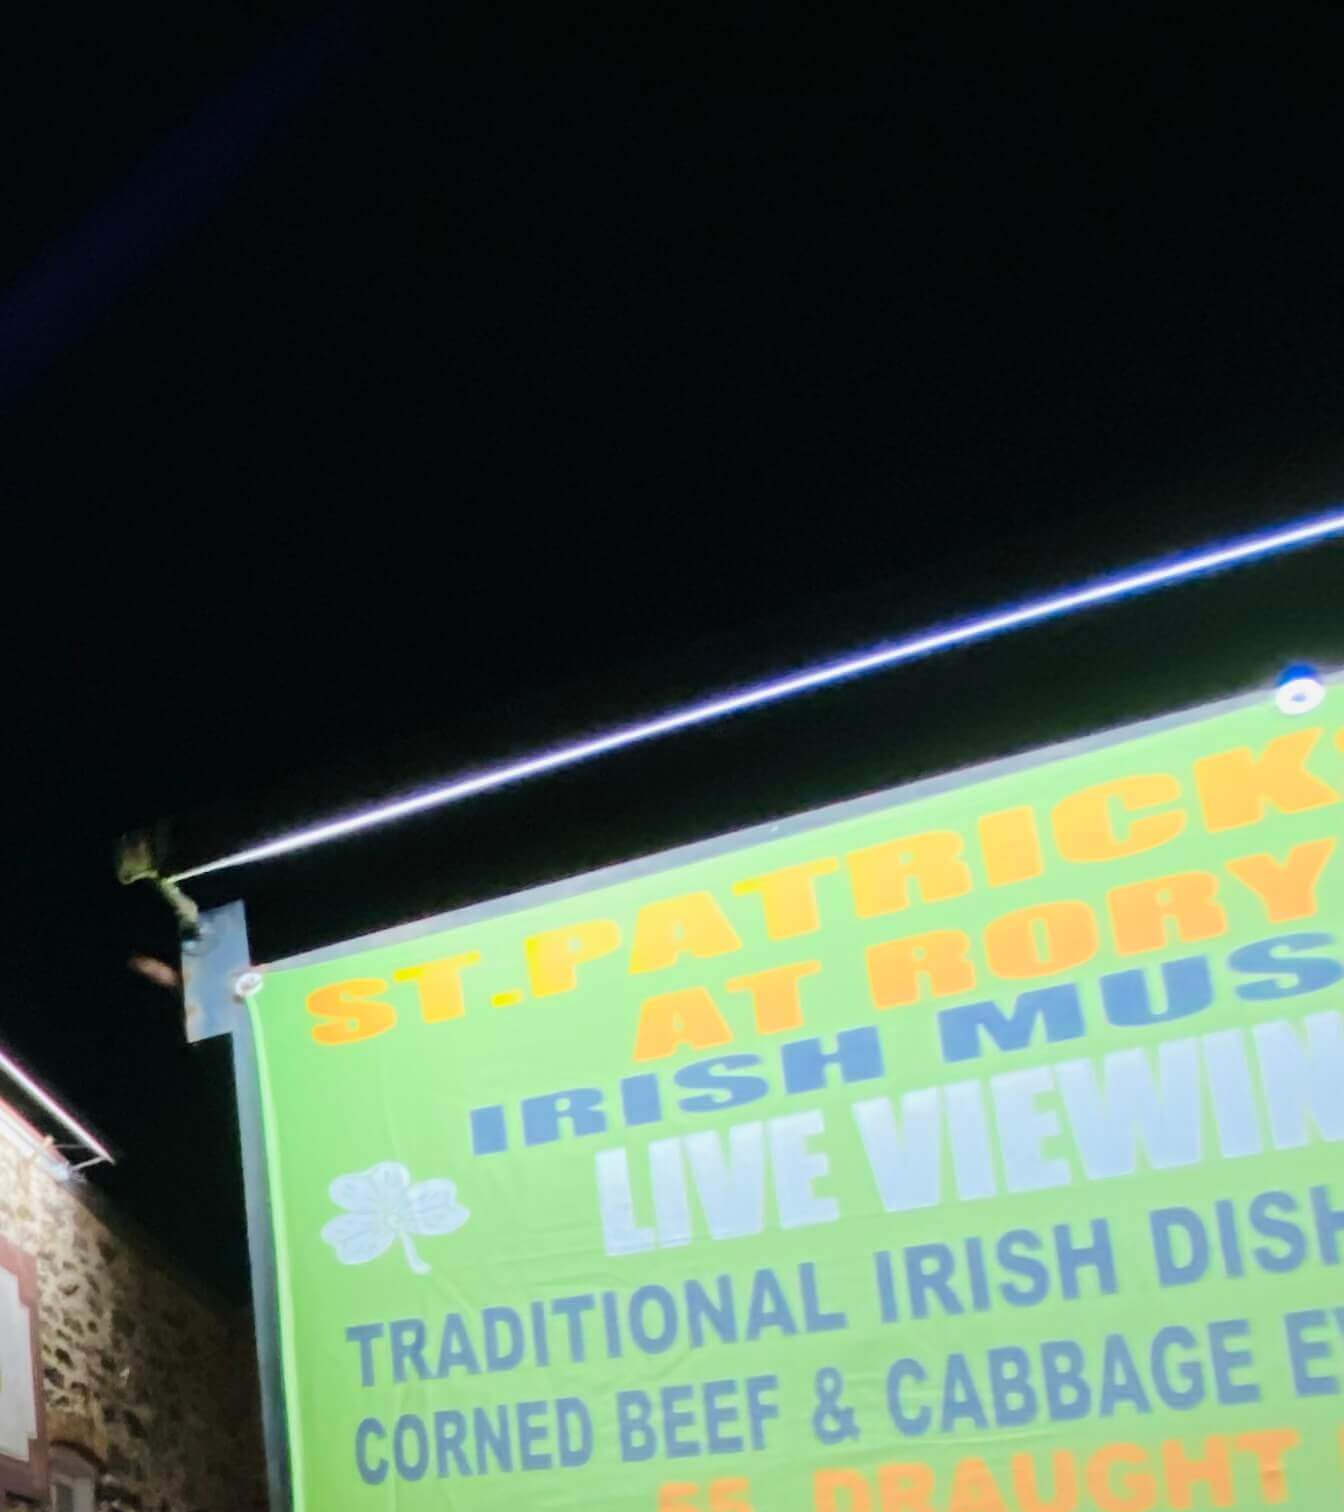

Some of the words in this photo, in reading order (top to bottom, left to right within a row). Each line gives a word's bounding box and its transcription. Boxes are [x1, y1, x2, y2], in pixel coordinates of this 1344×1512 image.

[304, 726, 1344, 1046] ST.PATRICK
[631, 961, 823, 1063] AT
[866, 837, 1337, 1011] RORY
[468, 1026, 886, 1157] IRISH
[936, 931, 1344, 1063] MUS
[594, 1108, 841, 1258] LIVE
[853, 1008, 1344, 1214] VIEWIN
[345, 1261, 847, 1388] TRADITIONAL
[873, 1217, 1118, 1325] IRISH
[353, 1395, 594, 1487] CORNED
[617, 1373, 781, 1464] BEEF
[812, 1366, 862, 1445] &
[885, 1319, 1262, 1438] CABBAGE
[1283, 1303, 1344, 1400] E
